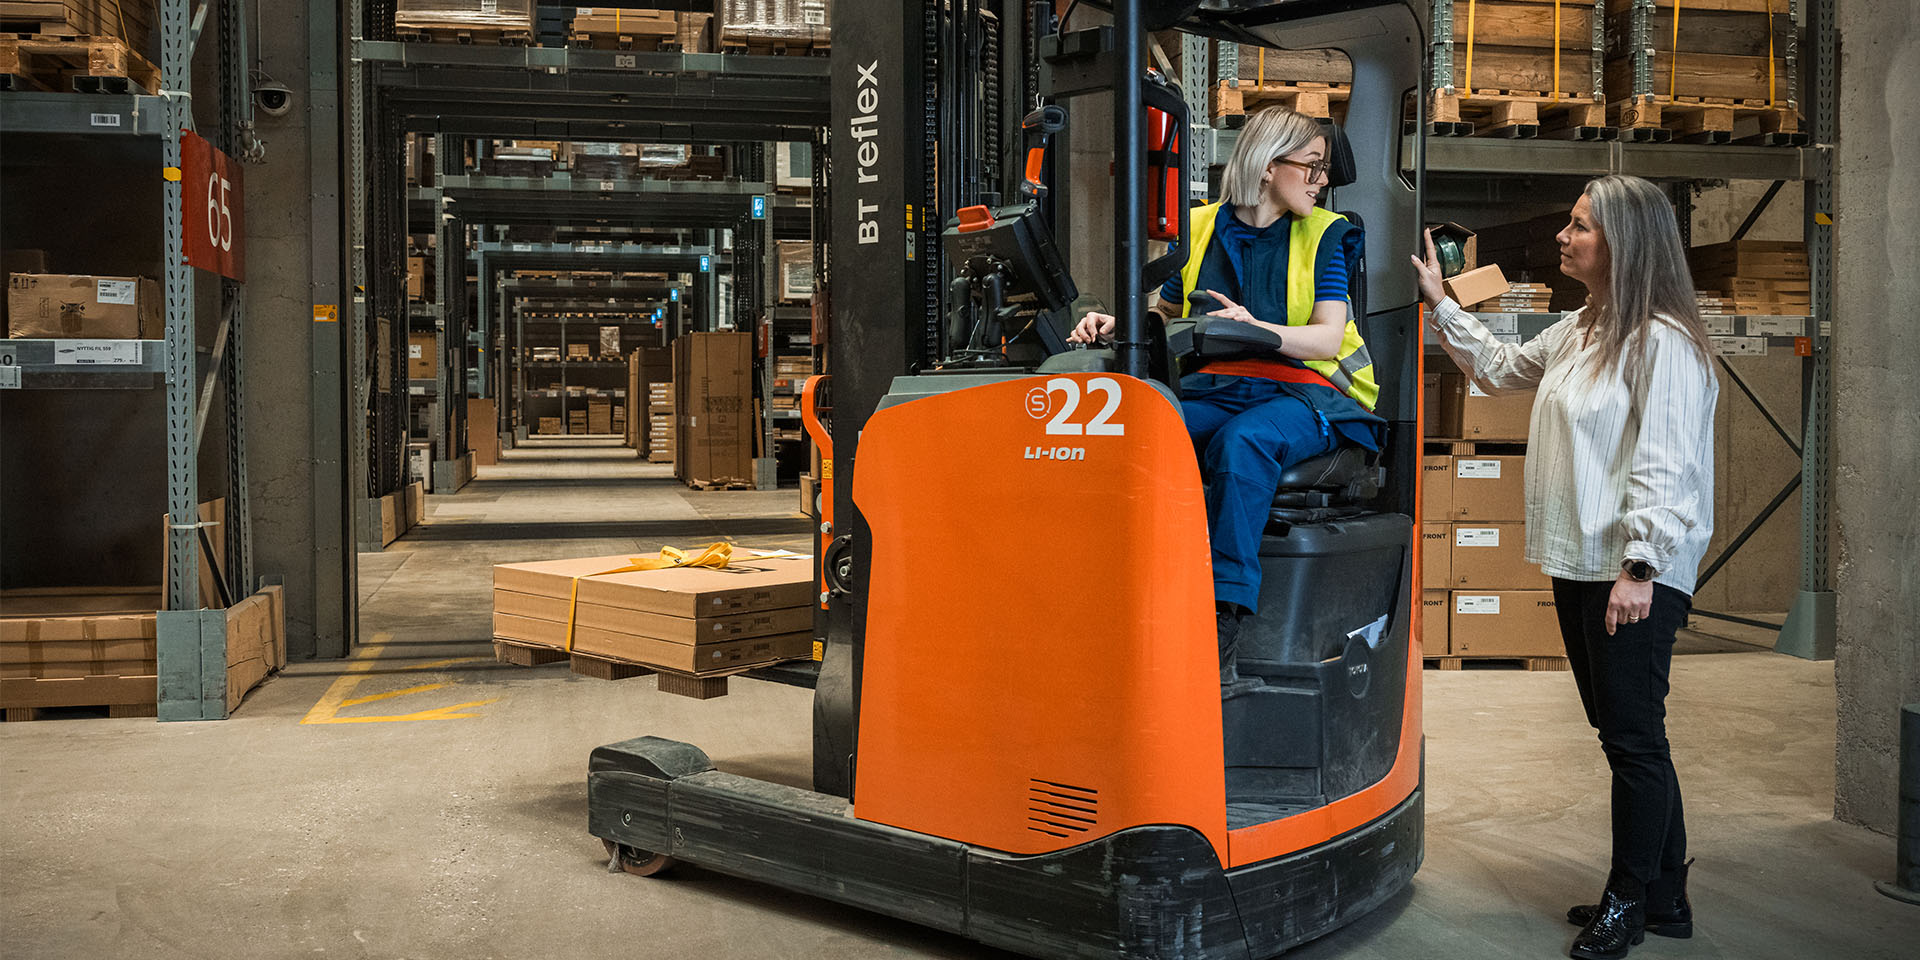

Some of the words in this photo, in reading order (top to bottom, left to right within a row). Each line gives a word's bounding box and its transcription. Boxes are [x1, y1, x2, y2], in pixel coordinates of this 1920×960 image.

[850, 59, 879, 184] reflex
[207, 172, 231, 252] 65
[858, 199, 879, 245] BT
[1801, 344, 1805, 354] 1
[1046, 377, 1125, 436] 22
